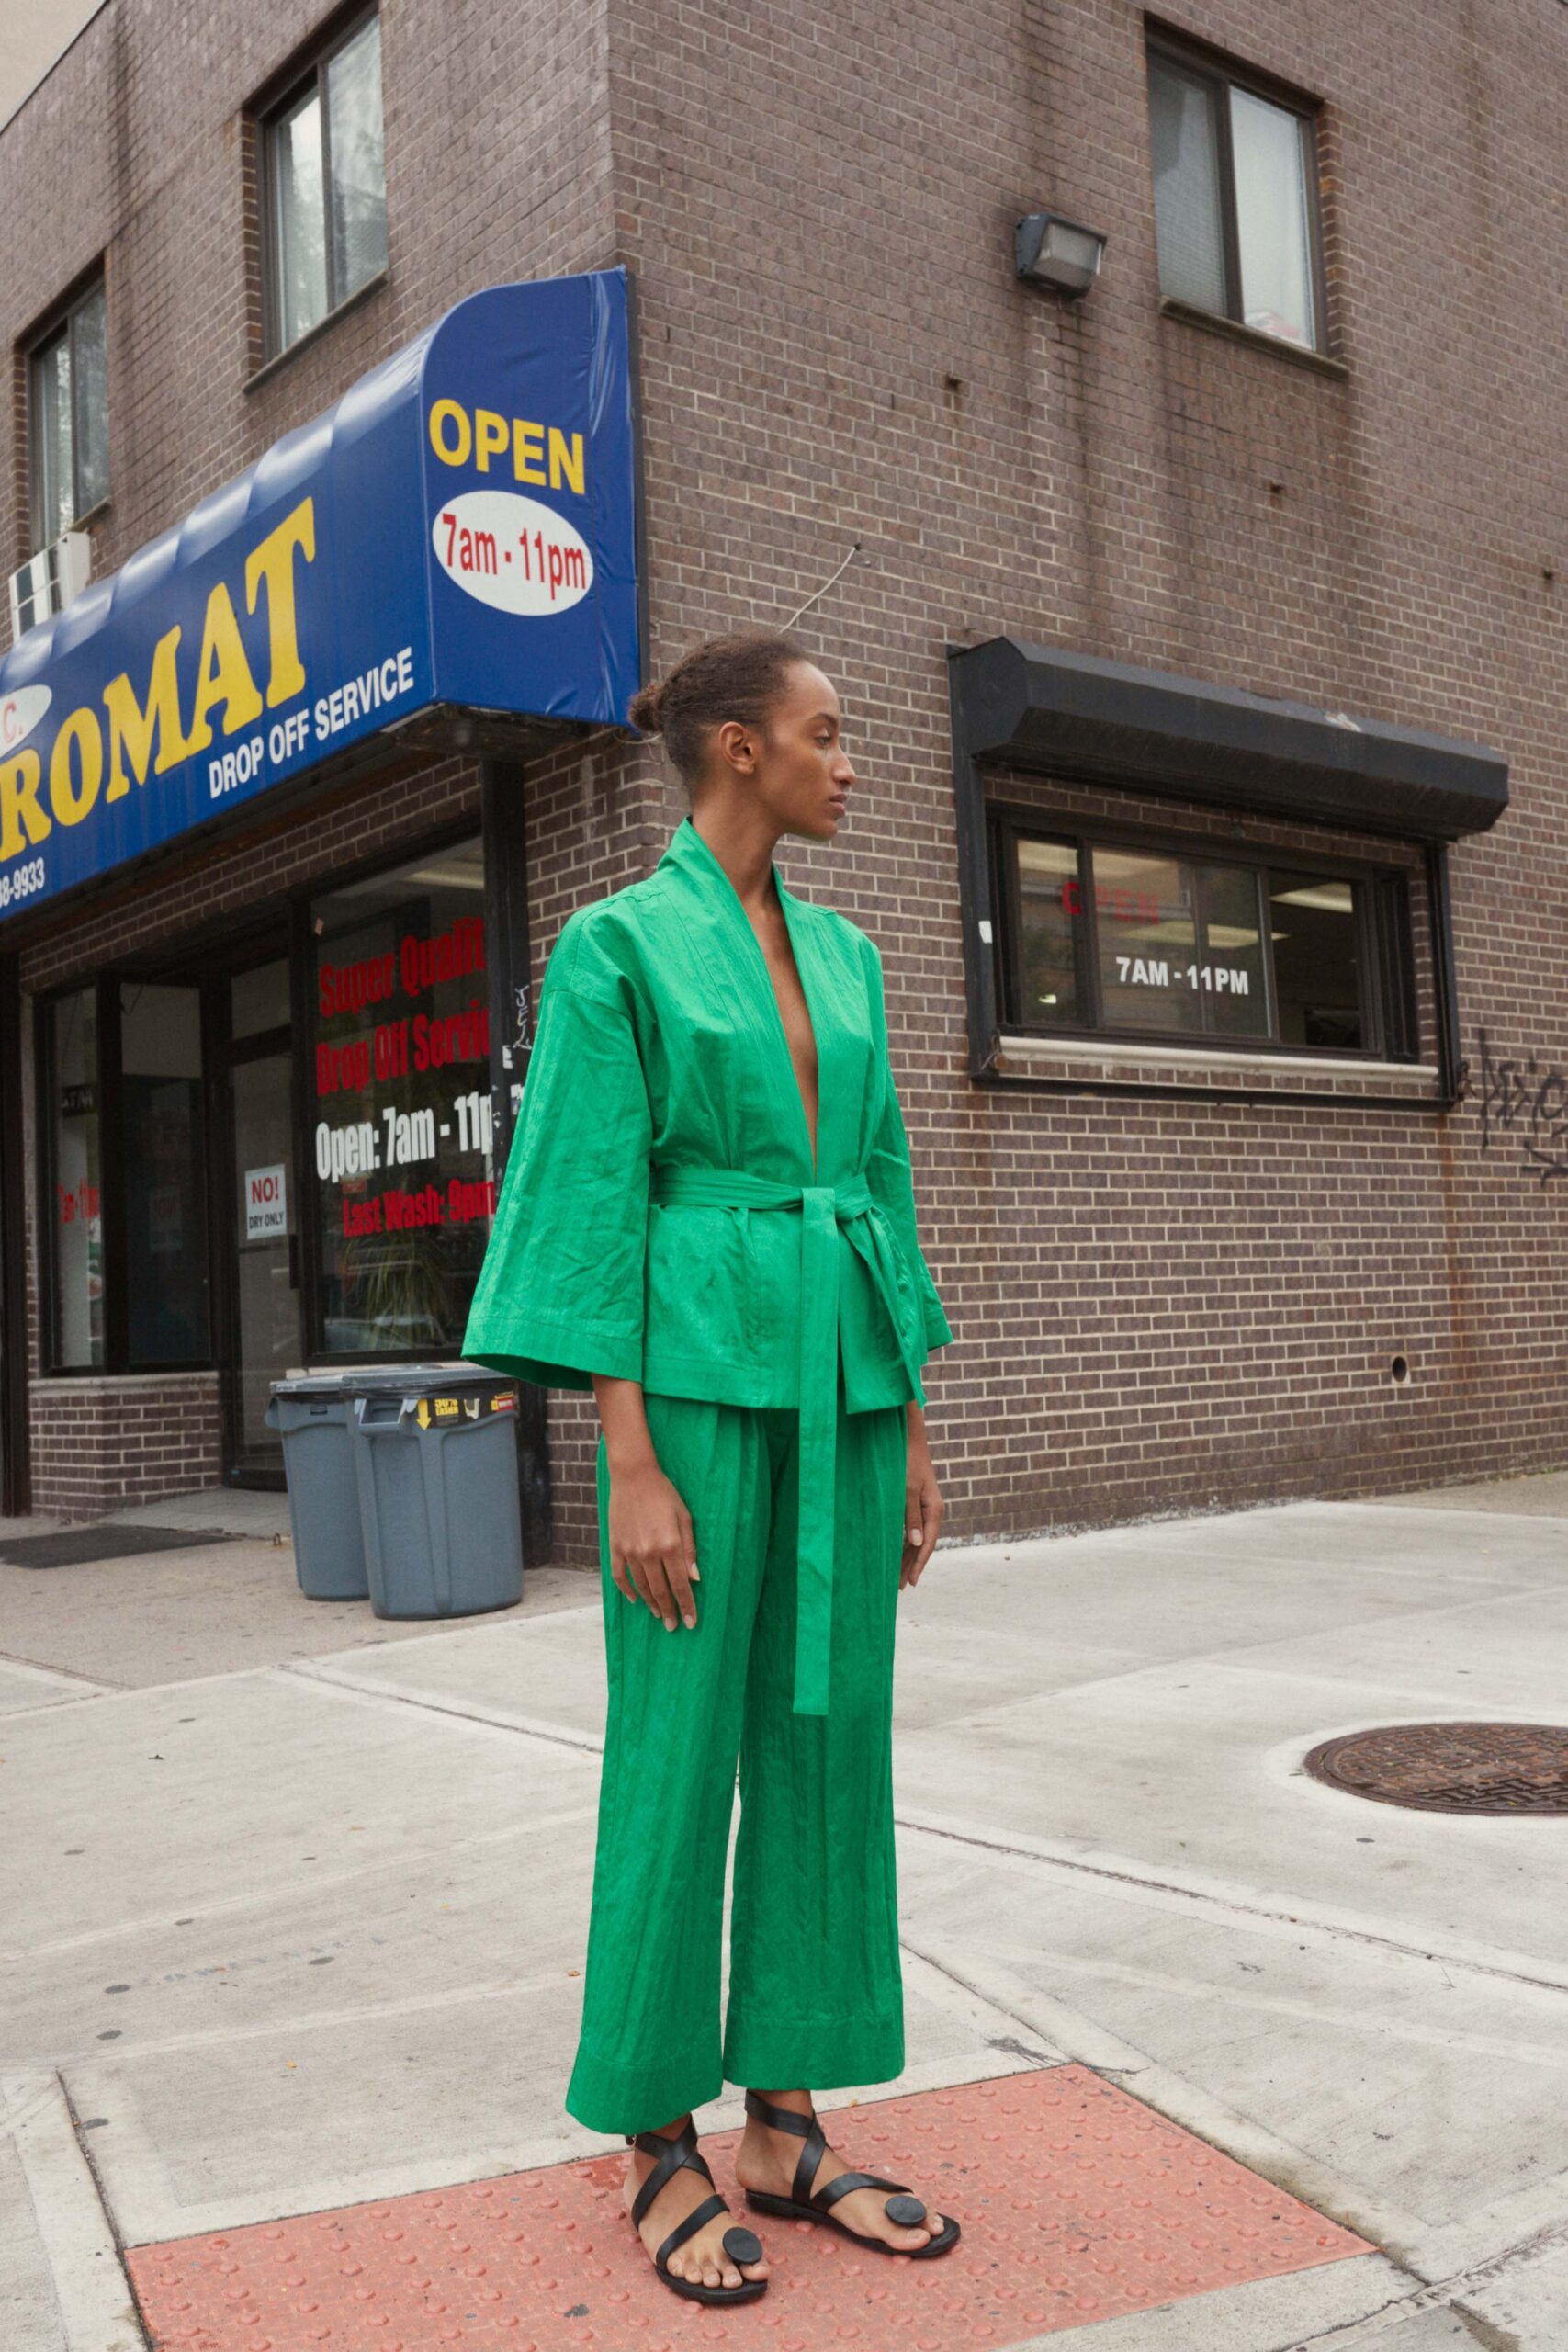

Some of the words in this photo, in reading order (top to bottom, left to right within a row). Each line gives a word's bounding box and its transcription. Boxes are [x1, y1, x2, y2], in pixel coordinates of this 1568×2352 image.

[429, 398, 585, 495] OPEN
[442, 513, 498, 575] 7am
[505, 551, 511, 562] -
[519, 528, 586, 600] 11pm
[0, 496, 315, 862] ROMAT
[209, 735, 265, 799] DROP
[269, 708, 310, 764] OFF
[314, 646, 414, 741] SERVICE
[321, 951, 395, 1018] Super
[1116, 956, 1168, 987] 7AM
[1187, 965, 1249, 995] 11PM
[317, 1039, 368, 1096] Drop
[374, 1019, 408, 1083] Off
[315, 1121, 381, 1183] Open:
[382, 1106, 435, 1167] 7am
[251, 1175, 279, 1204] NO!
[265, 1210, 284, 1227] ONLY
[343, 1197, 382, 1238] Last
[383, 1183, 446, 1231] Wash:
[447, 1178, 496, 1224] 9pm
